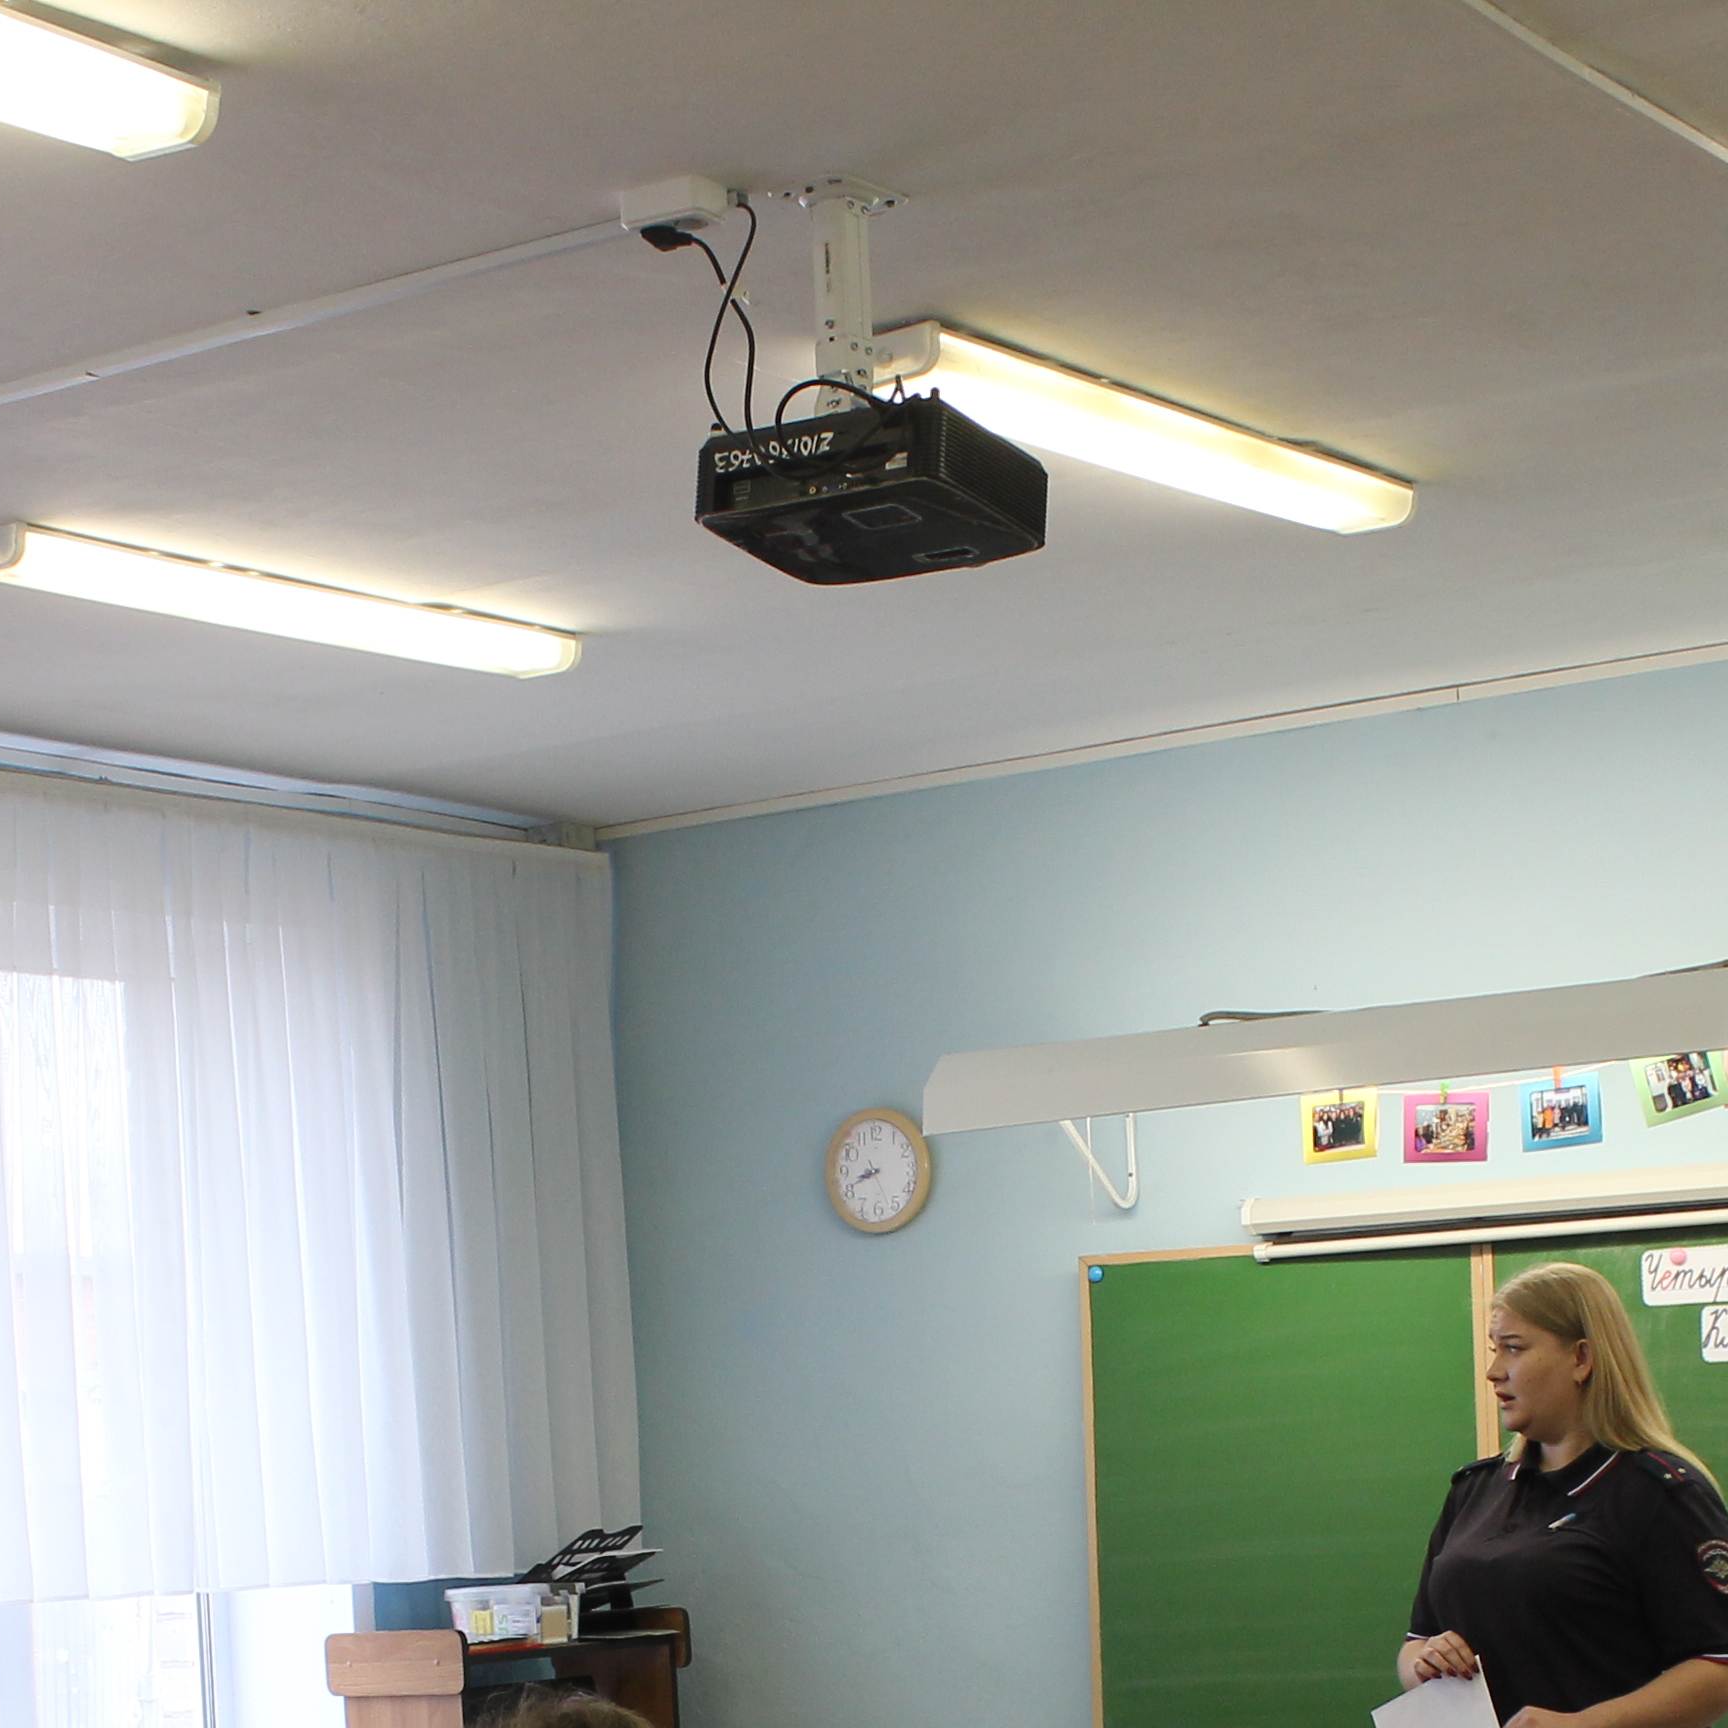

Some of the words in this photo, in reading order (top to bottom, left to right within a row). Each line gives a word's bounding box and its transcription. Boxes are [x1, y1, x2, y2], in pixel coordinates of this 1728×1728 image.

[858, 1131, 866, 1146] 11
[870, 1125, 883, 1141] 12
[844, 1146, 859, 1162] 10
[901, 1143, 910, 1158] 2
[840, 1165, 849, 1179] 9
[906, 1161, 916, 1177] 3
[844, 1184, 855, 1199] 8
[902, 1181, 916, 1194] 4
[858, 1197, 866, 1213] 7
[873, 1201, 884, 1216] 6
[891, 1195, 900, 1212] 5
